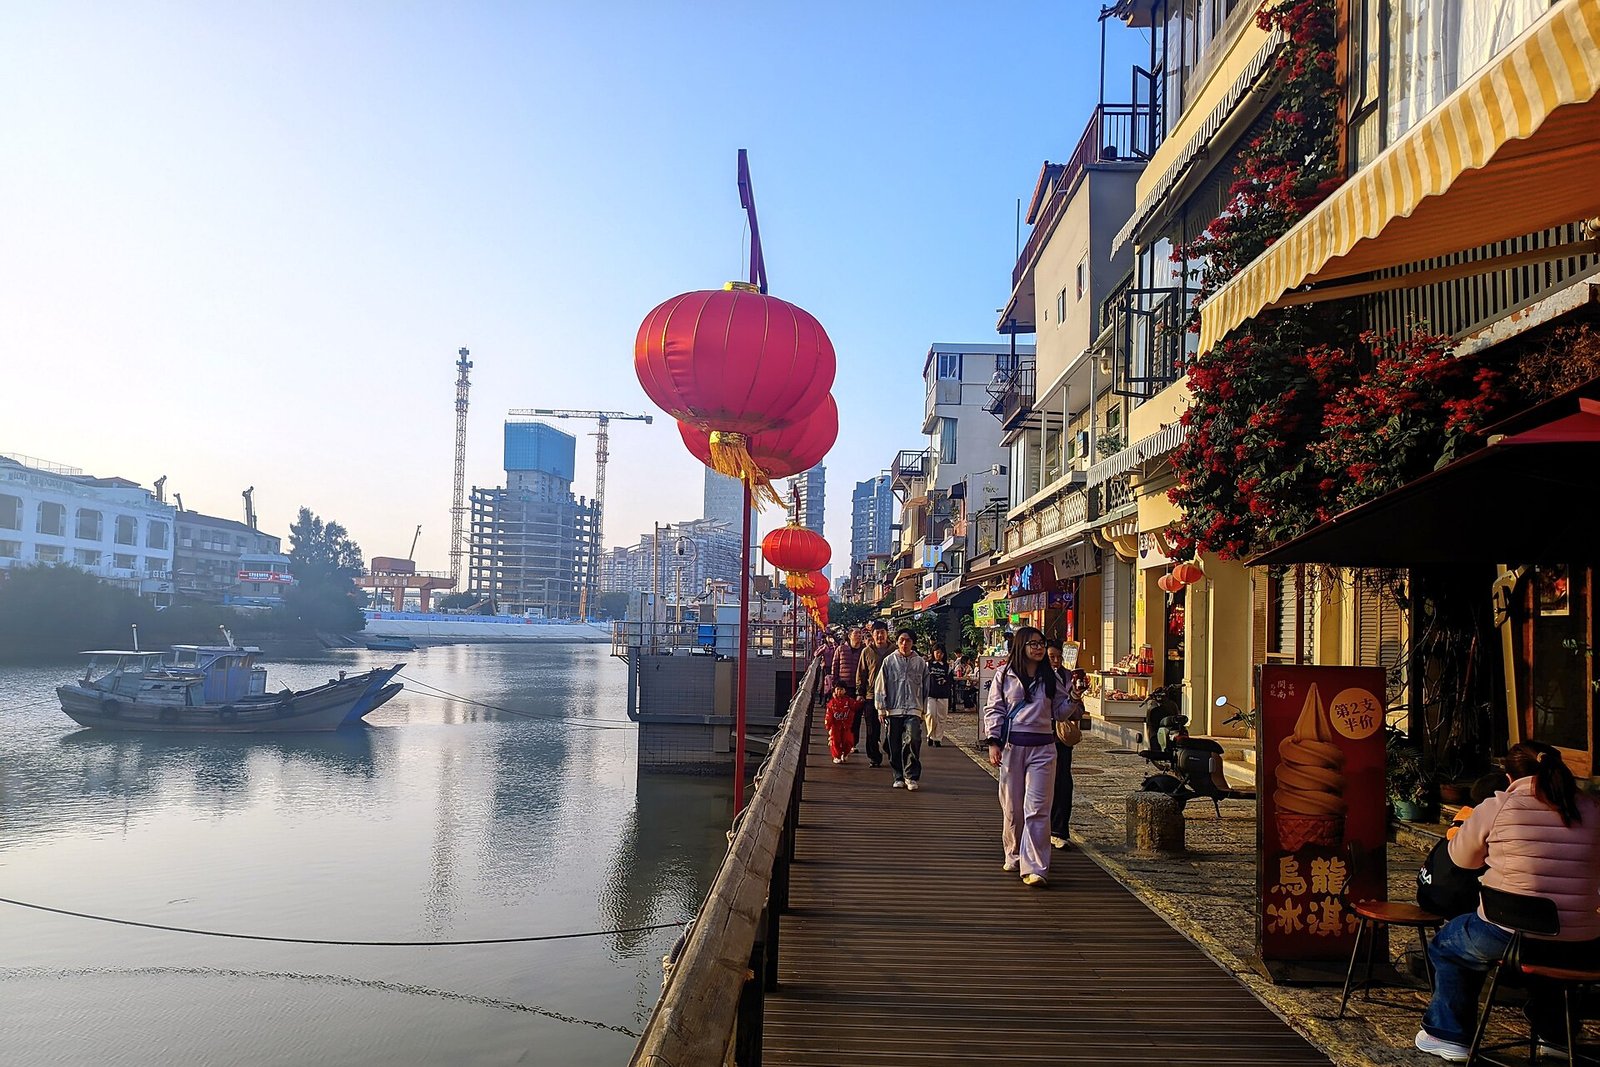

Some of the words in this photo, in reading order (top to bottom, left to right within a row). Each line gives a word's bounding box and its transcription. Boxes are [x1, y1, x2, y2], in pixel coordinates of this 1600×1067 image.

[1335, 698, 1375, 718] 第2支
[1344, 715, 1373, 732] 半价
[1270, 854, 1350, 895] 烏龍
[1266, 896, 1385, 937] 冰淇
